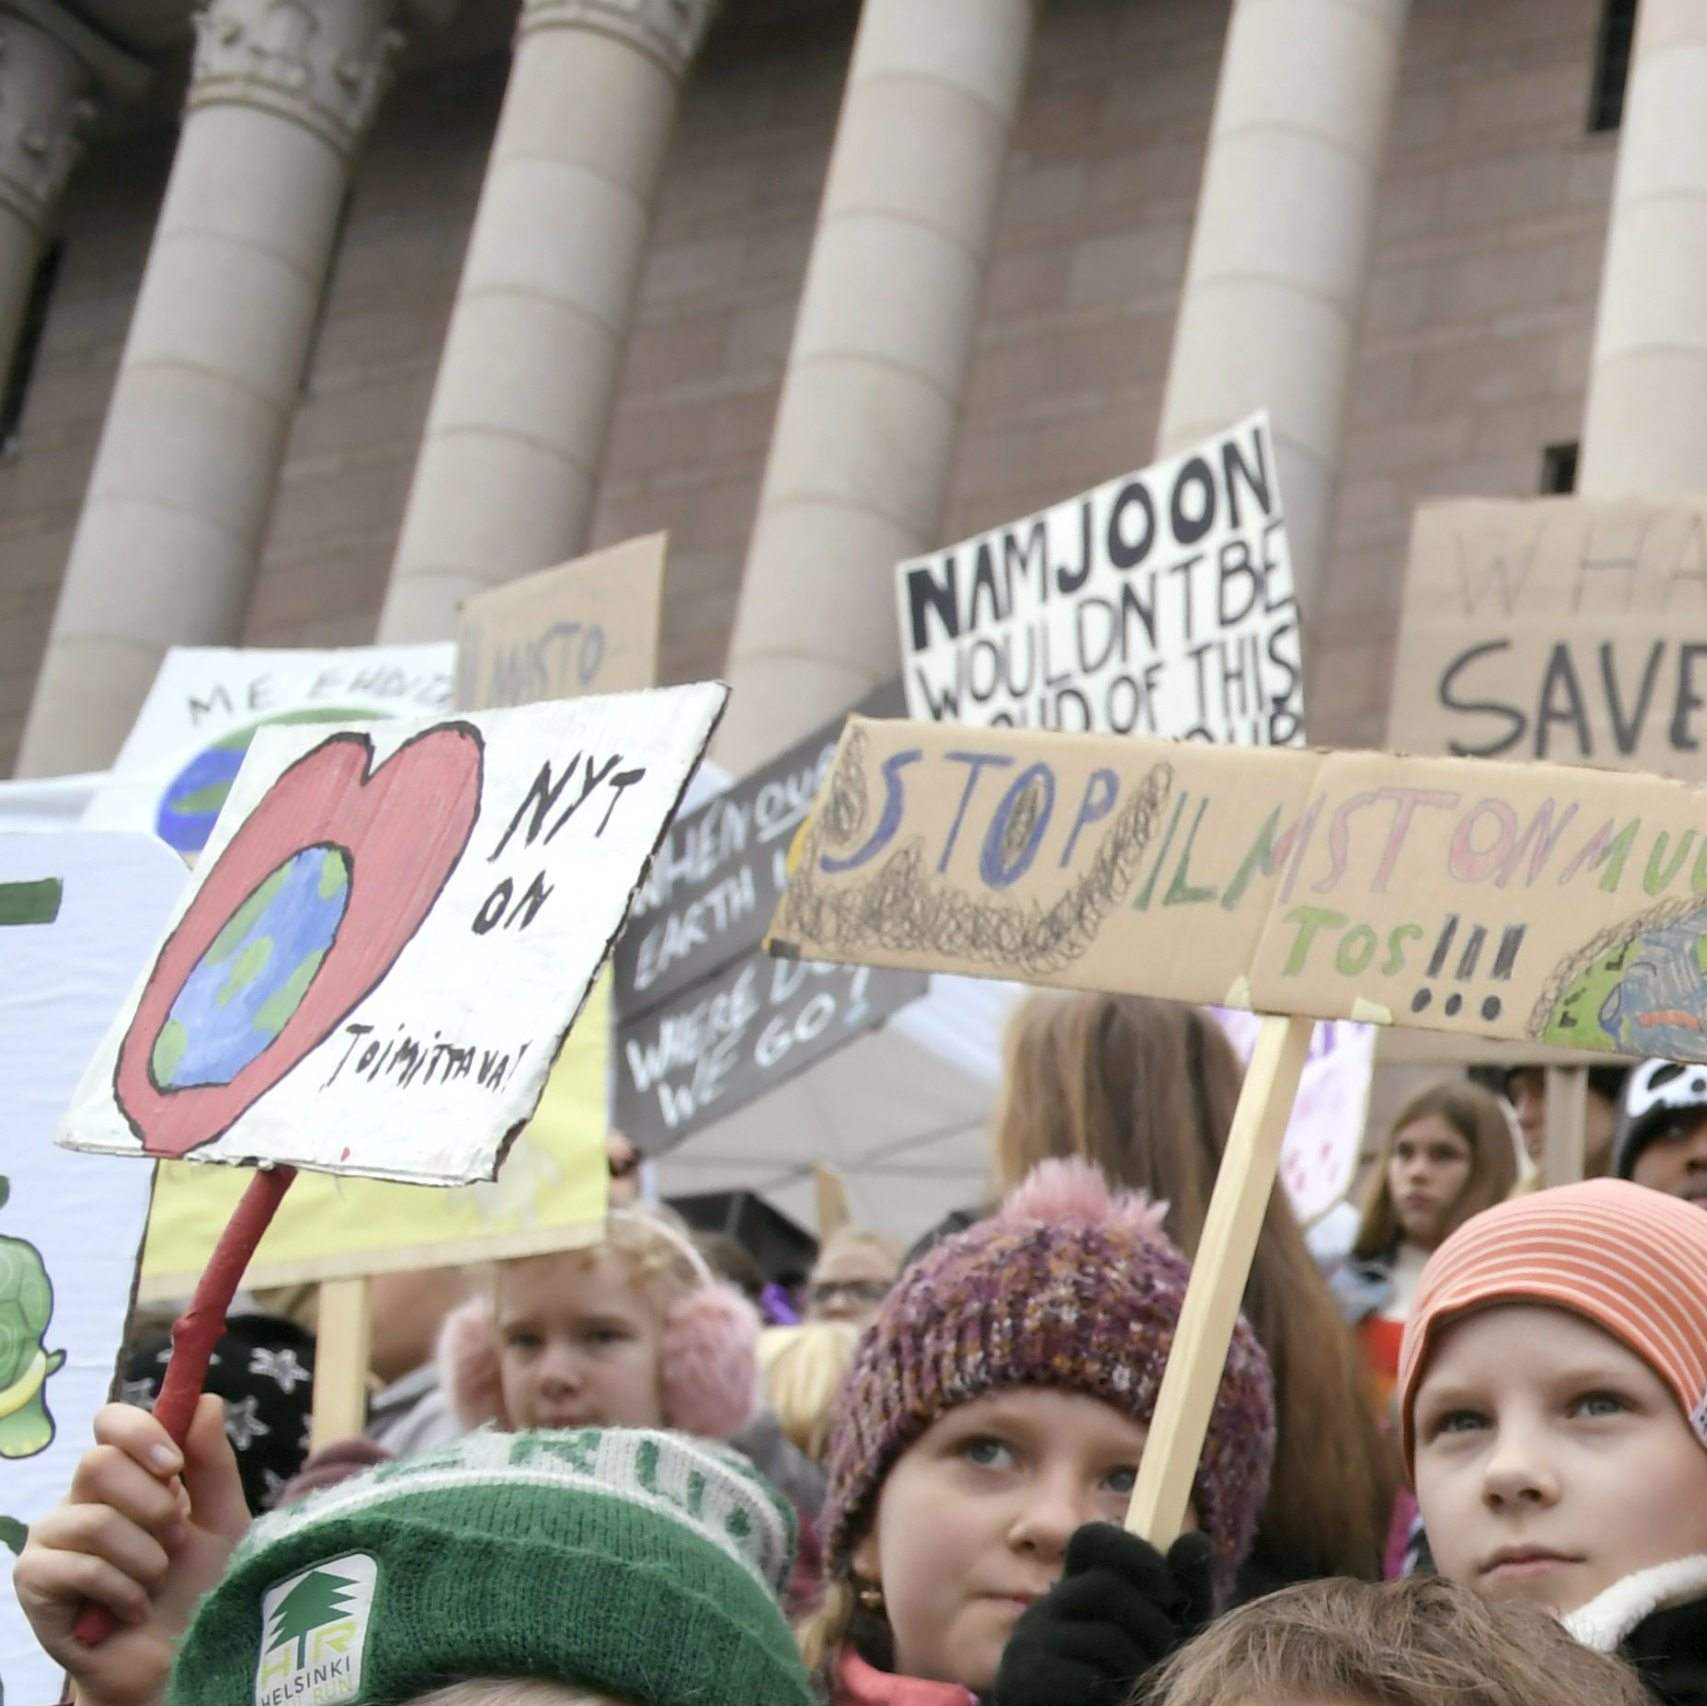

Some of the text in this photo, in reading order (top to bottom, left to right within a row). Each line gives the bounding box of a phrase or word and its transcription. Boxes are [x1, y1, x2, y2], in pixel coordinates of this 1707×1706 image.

[906, 425, 1274, 654] NAMJOON
[1216, 518, 1297, 628] BE
[486, 749, 648, 863] NYT
[818, 746, 1122, 891] STOP
[470, 869, 555, 936] ON
[1280, 904, 1530, 1023] TOS!!!
